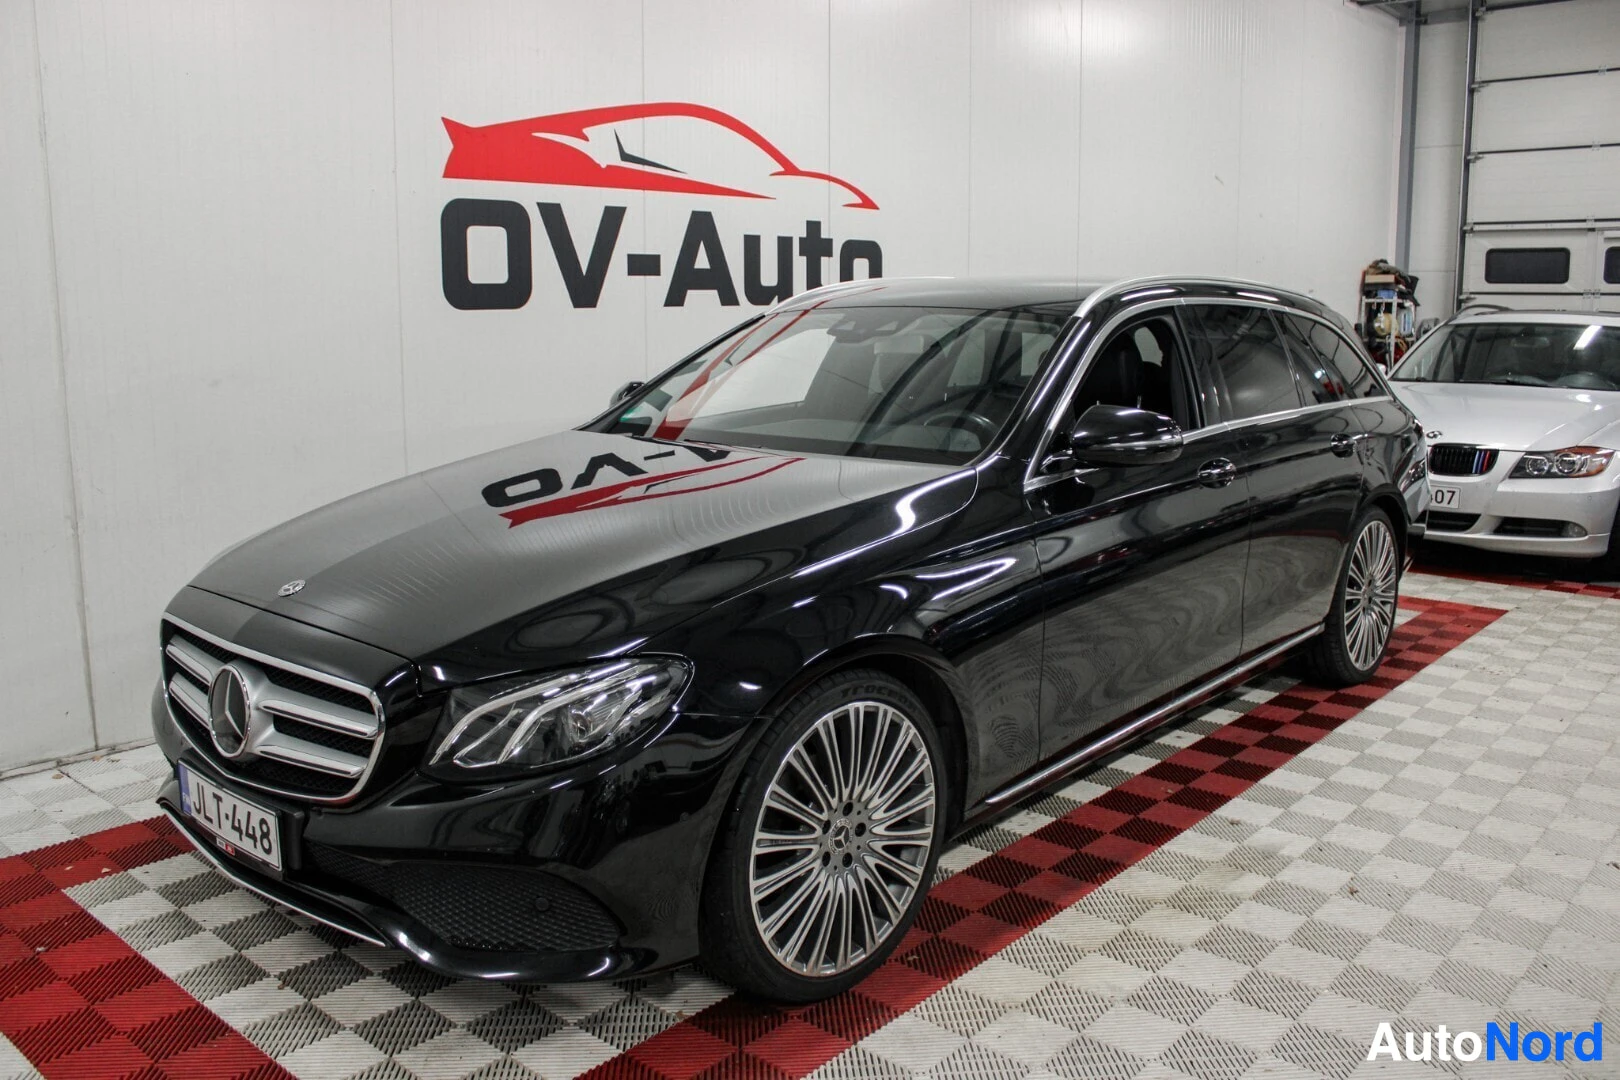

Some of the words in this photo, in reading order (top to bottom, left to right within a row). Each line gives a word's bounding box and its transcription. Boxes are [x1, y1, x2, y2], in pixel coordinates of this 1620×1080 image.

[440, 198, 883, 310] OV-Auto
[1430, 489, 1456, 505] 07
[193, 782, 272, 856] JLT-448
